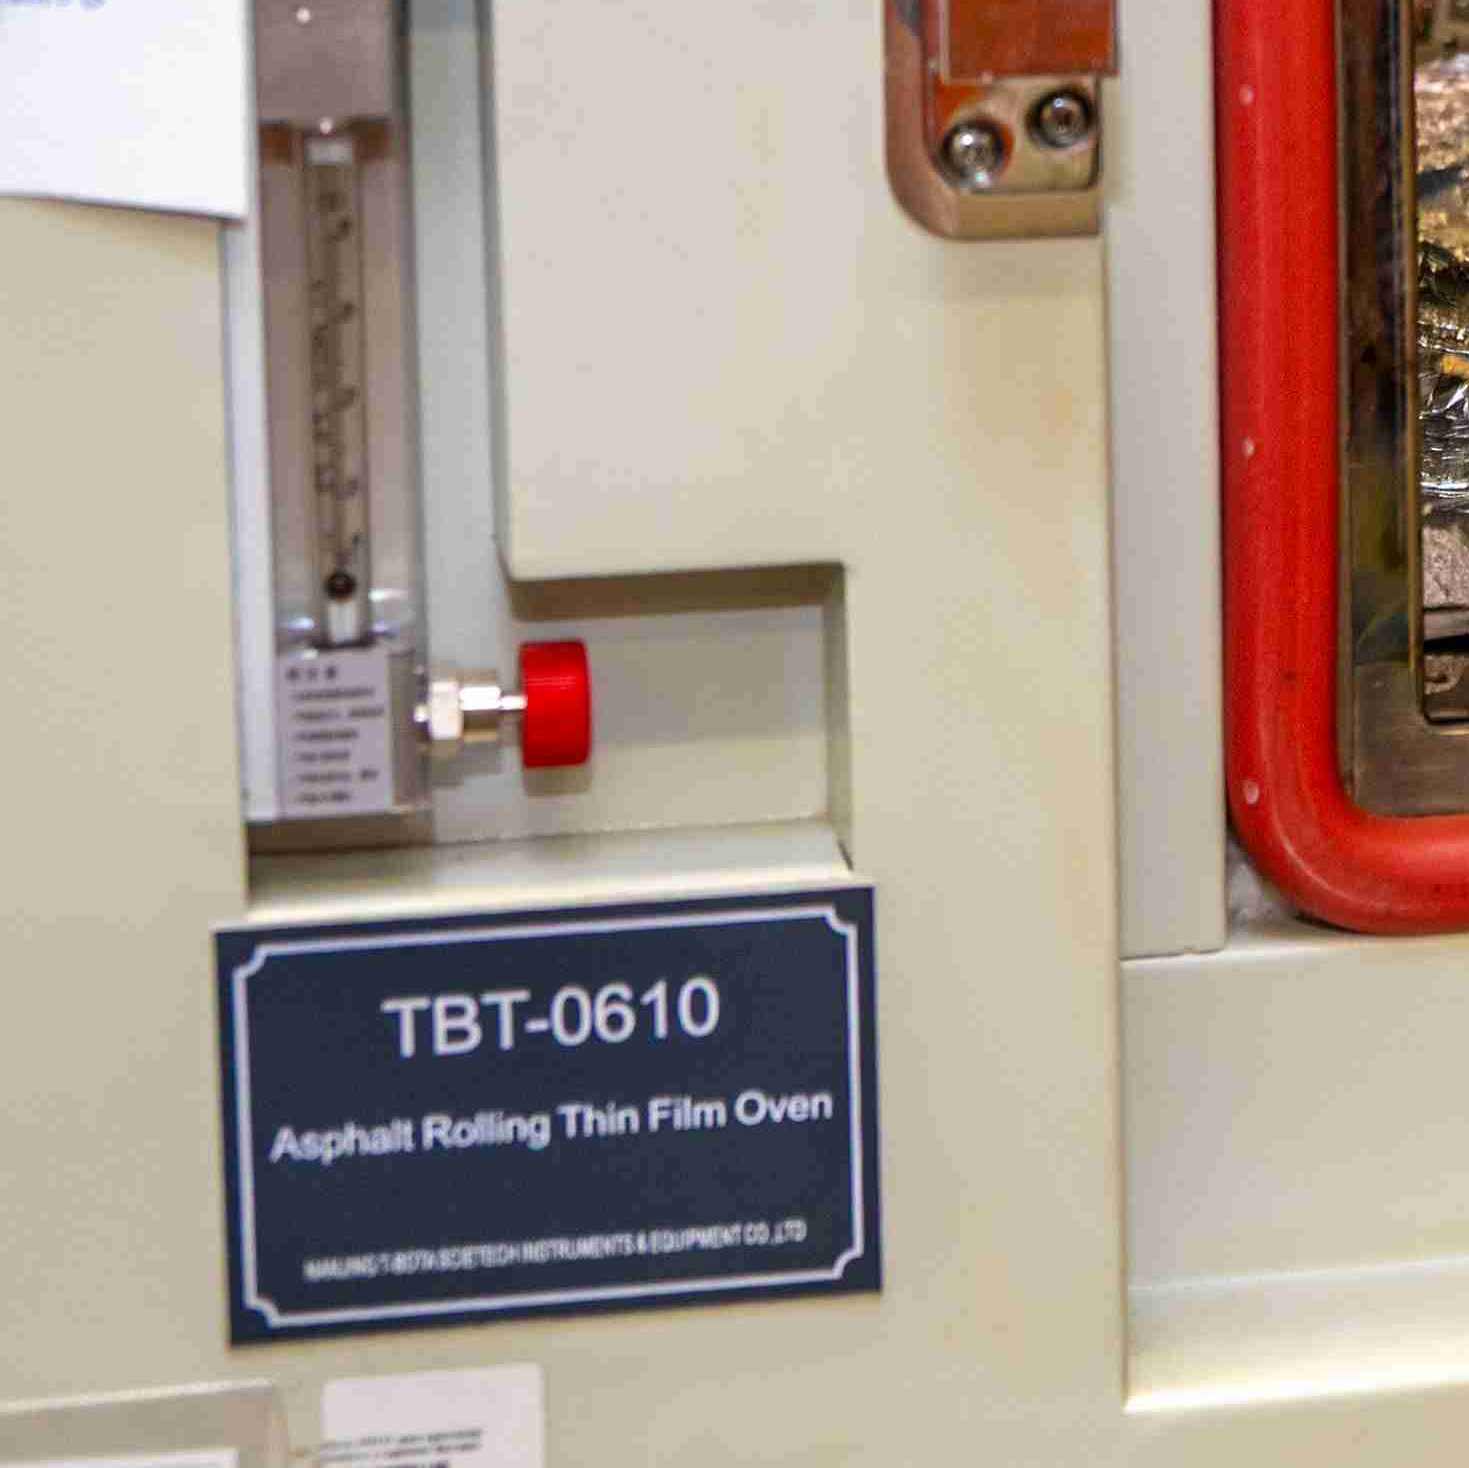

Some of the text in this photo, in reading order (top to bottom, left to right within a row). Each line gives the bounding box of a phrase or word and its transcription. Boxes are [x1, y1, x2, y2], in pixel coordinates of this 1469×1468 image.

[380, 976, 721, 1059] TBT-0610
[268, 1088, 834, 1167] Asphalt Rolling Thin Film Oven
